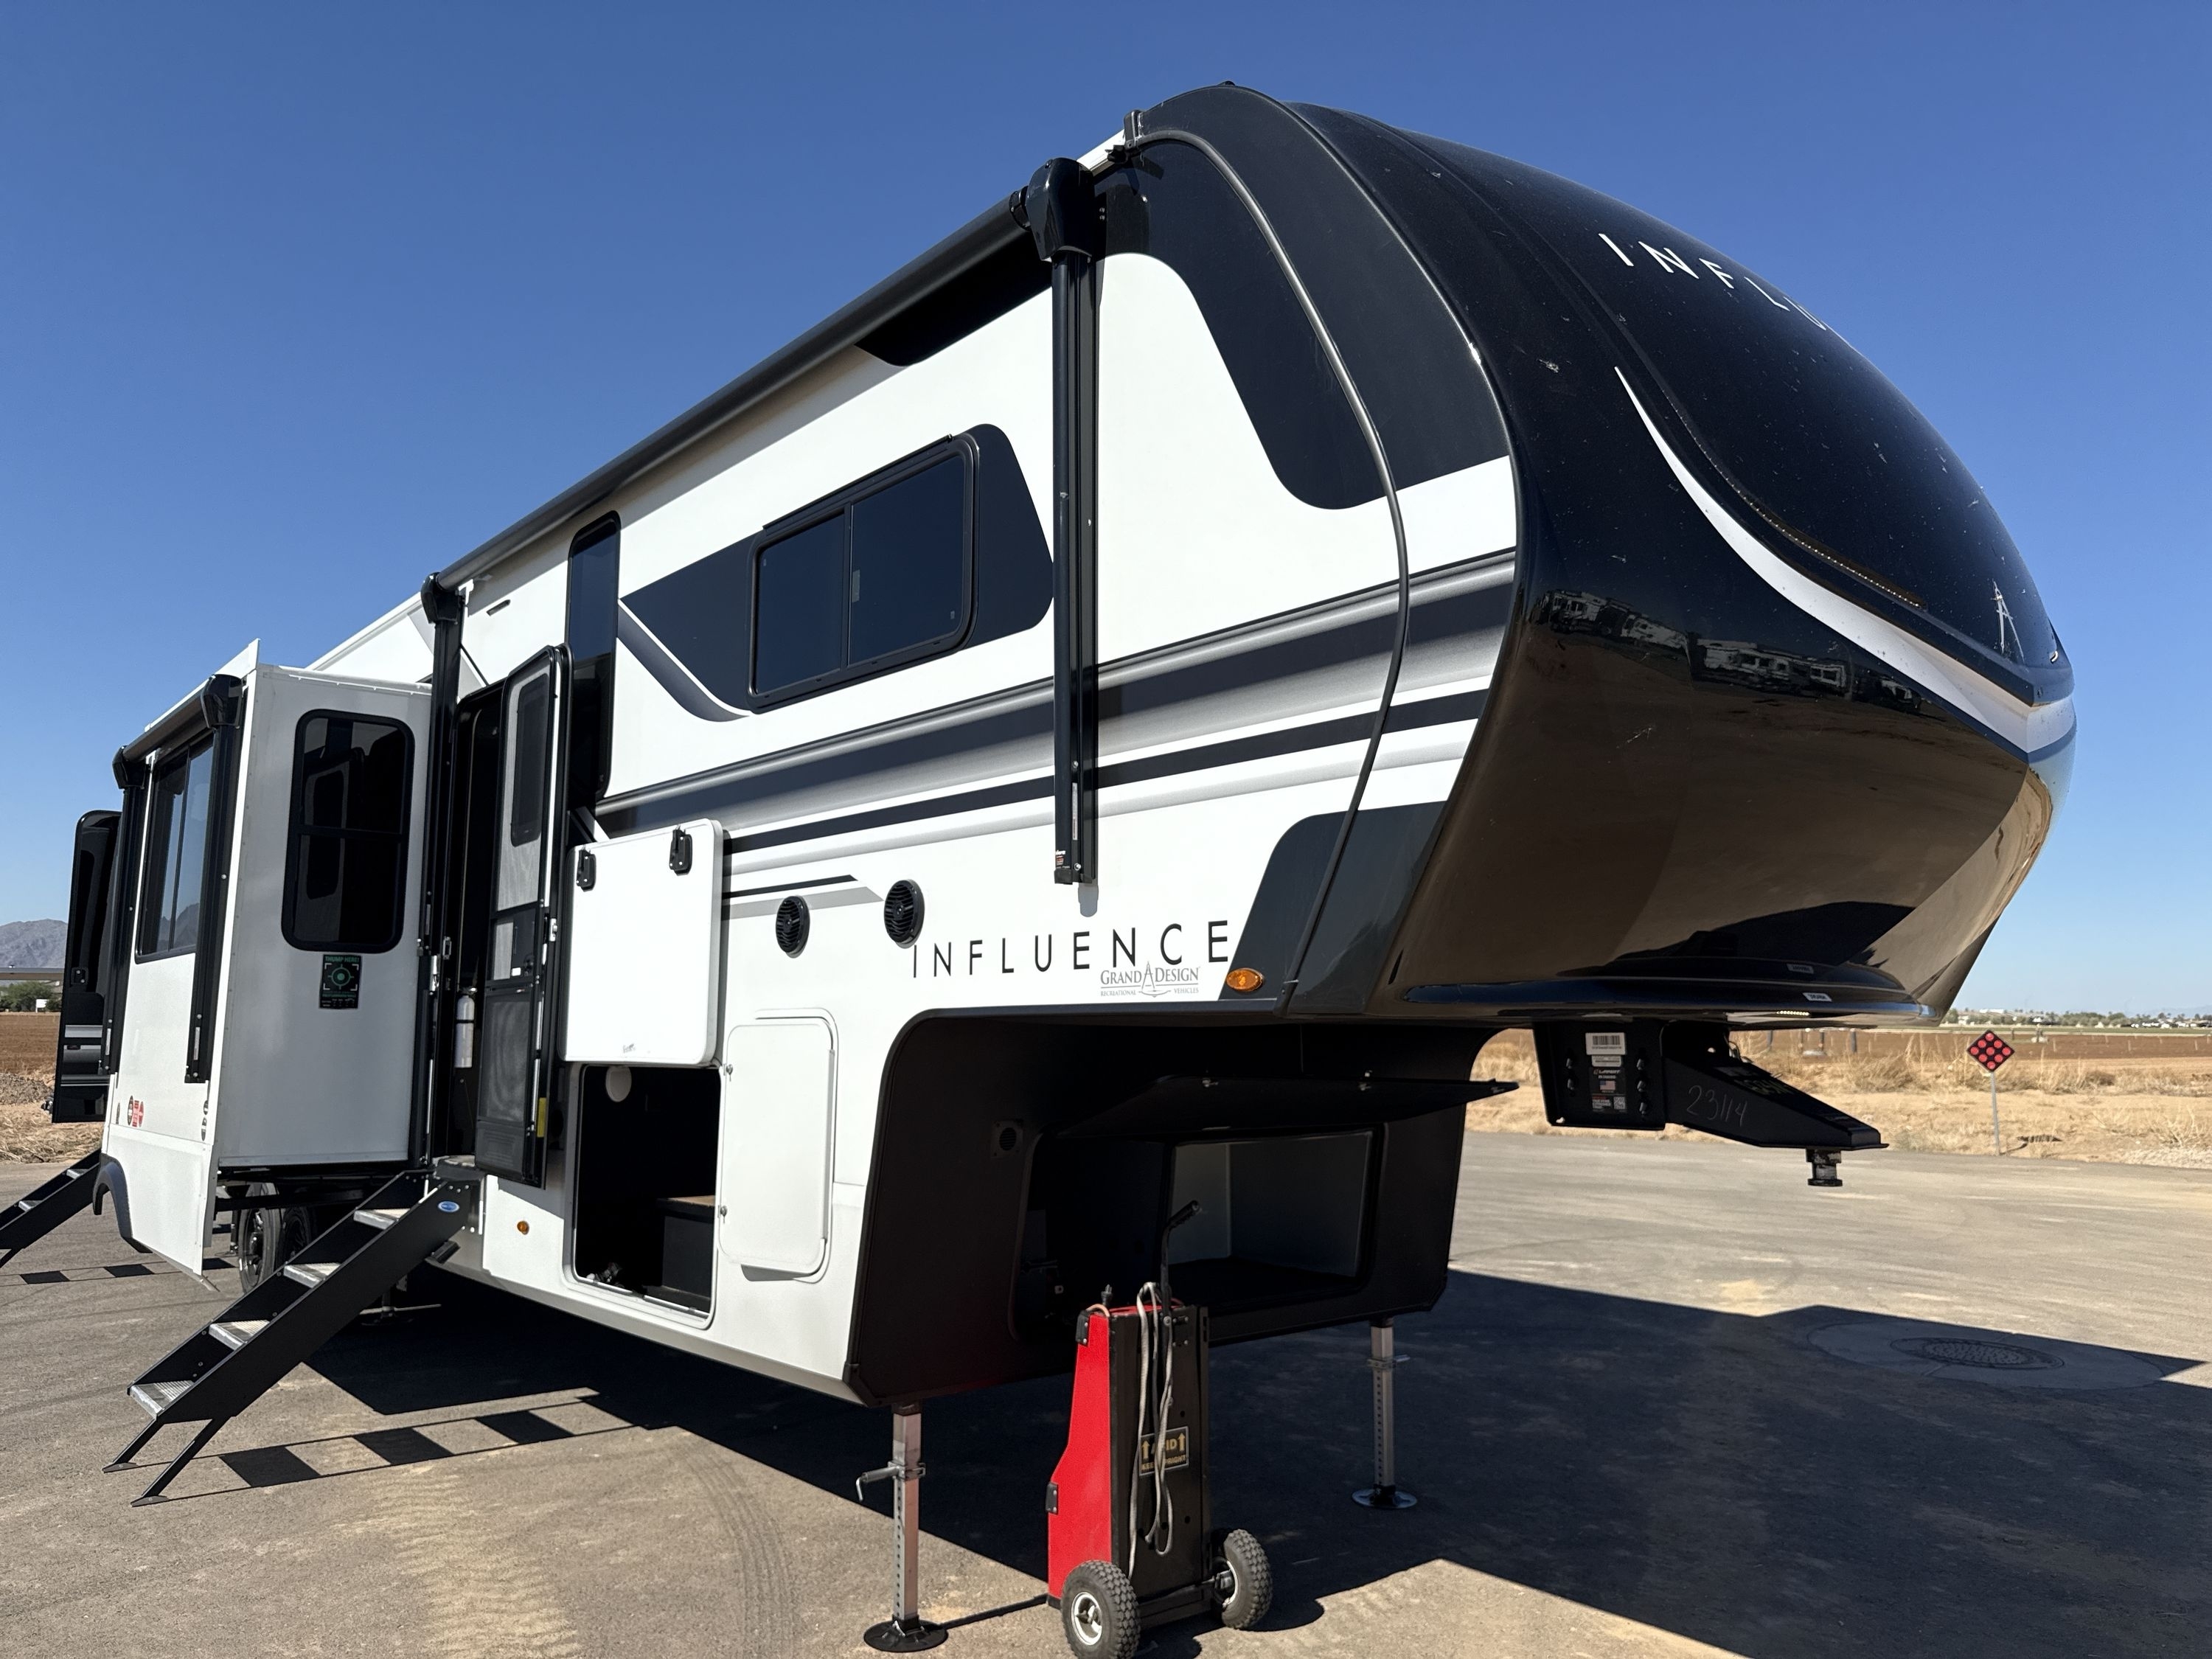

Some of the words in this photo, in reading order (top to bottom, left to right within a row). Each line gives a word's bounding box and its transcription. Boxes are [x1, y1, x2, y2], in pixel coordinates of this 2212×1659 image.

[913, 920, 1228, 978] INFLUENCE
[1100, 970, 1142, 985] GRAND
[1155, 967, 1199, 982] DESIGN
[1686, 1085, 1747, 1127] 23114
